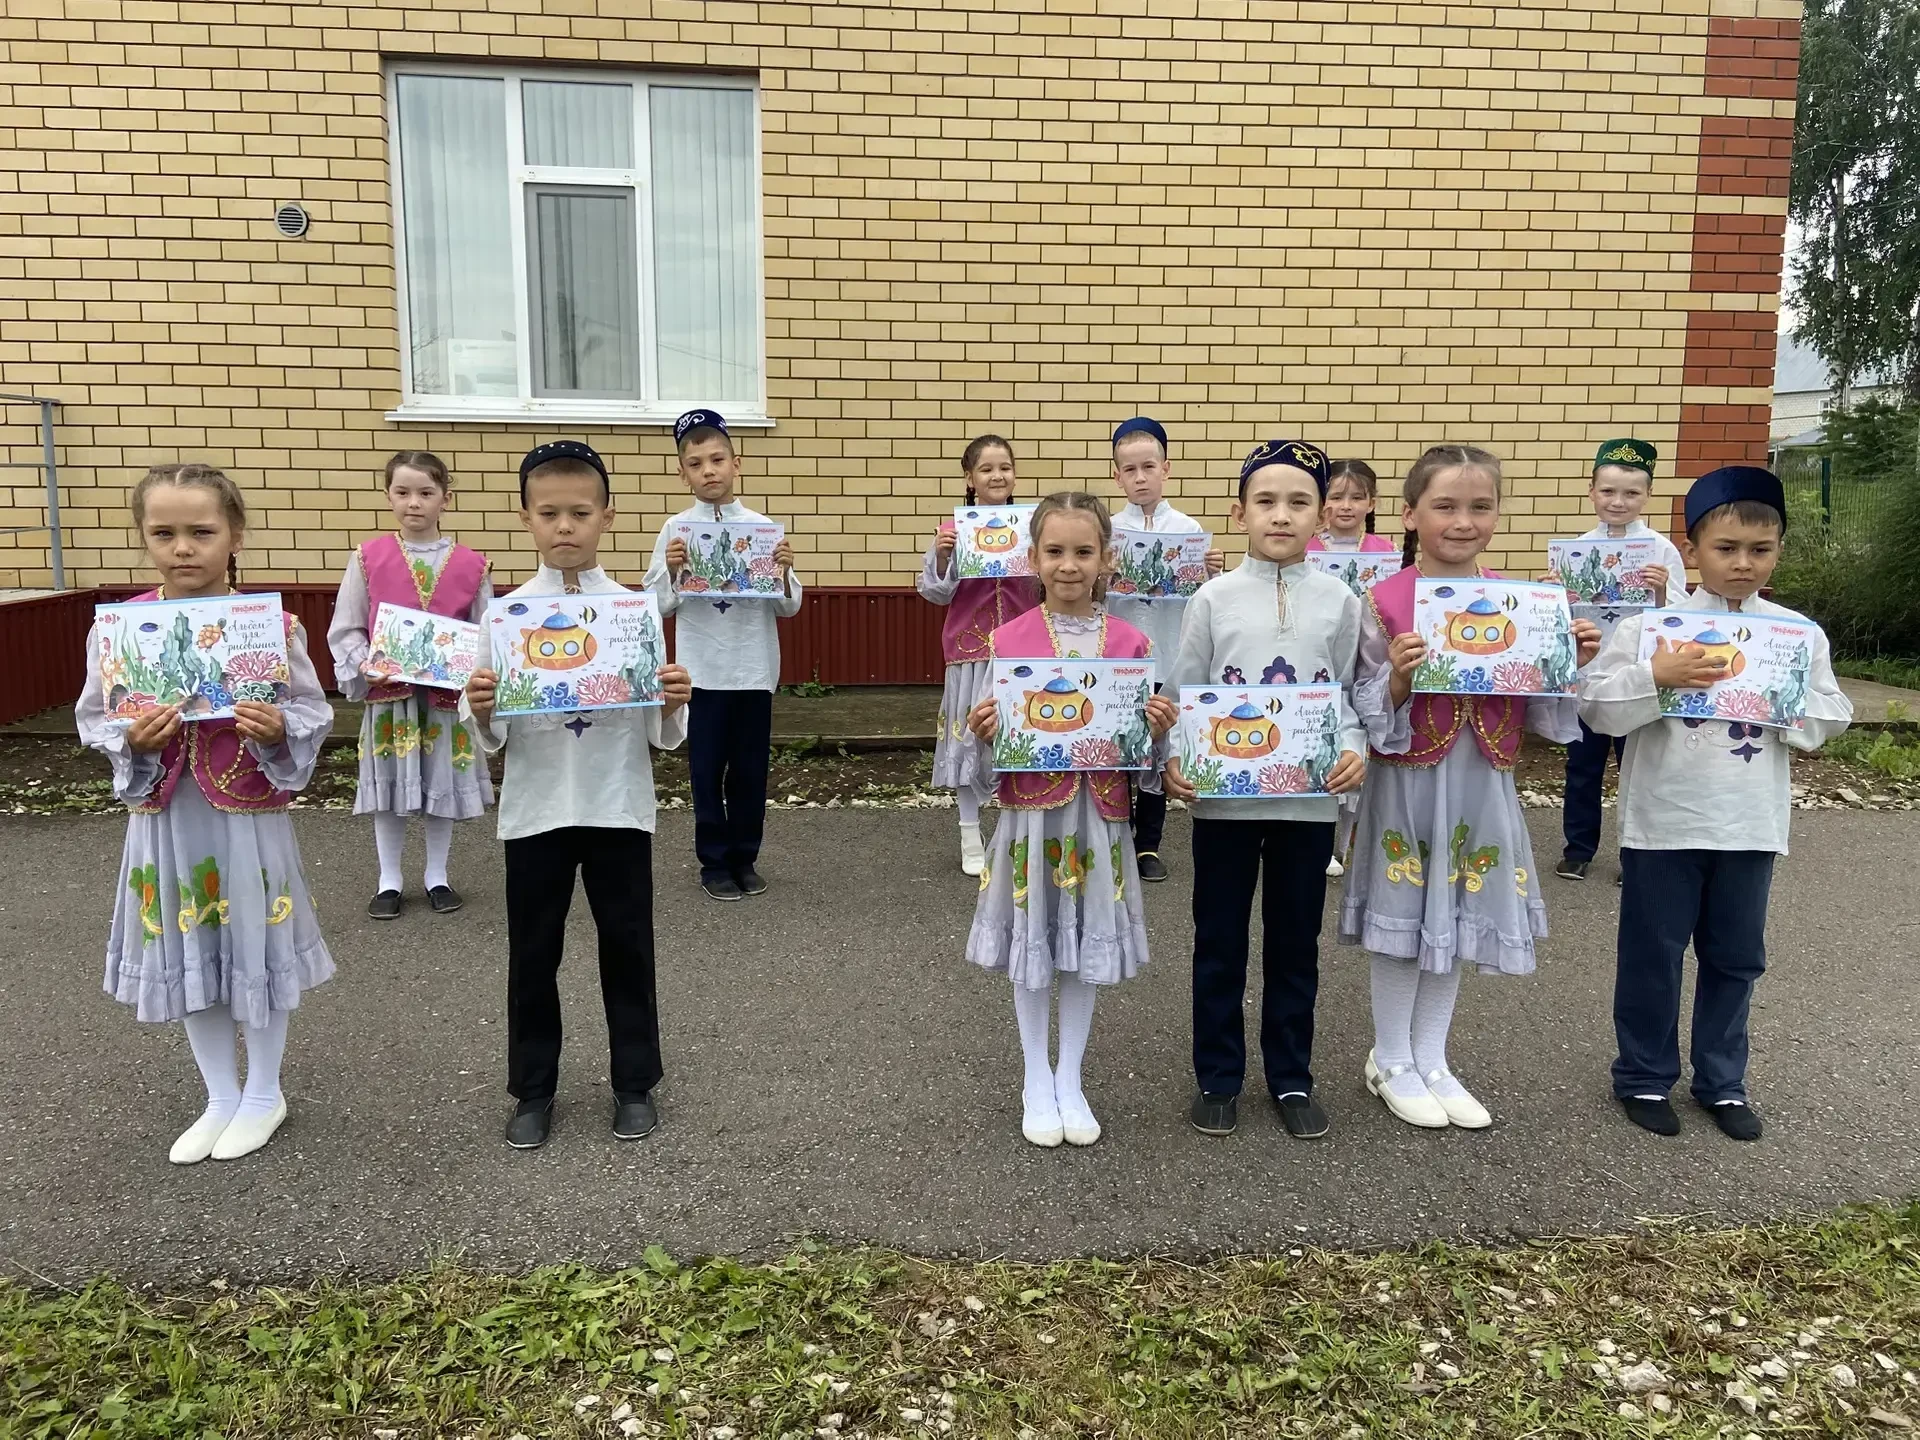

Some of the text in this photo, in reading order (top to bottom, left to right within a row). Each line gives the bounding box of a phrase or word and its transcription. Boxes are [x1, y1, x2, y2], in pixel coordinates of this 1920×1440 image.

[613, 600, 646, 608] ПИФАГОР
[228, 620, 272, 632] Альбом
[239, 631, 263, 644] для
[223, 639, 278, 656] рисования
[1101, 699, 1144, 714] рисовани
